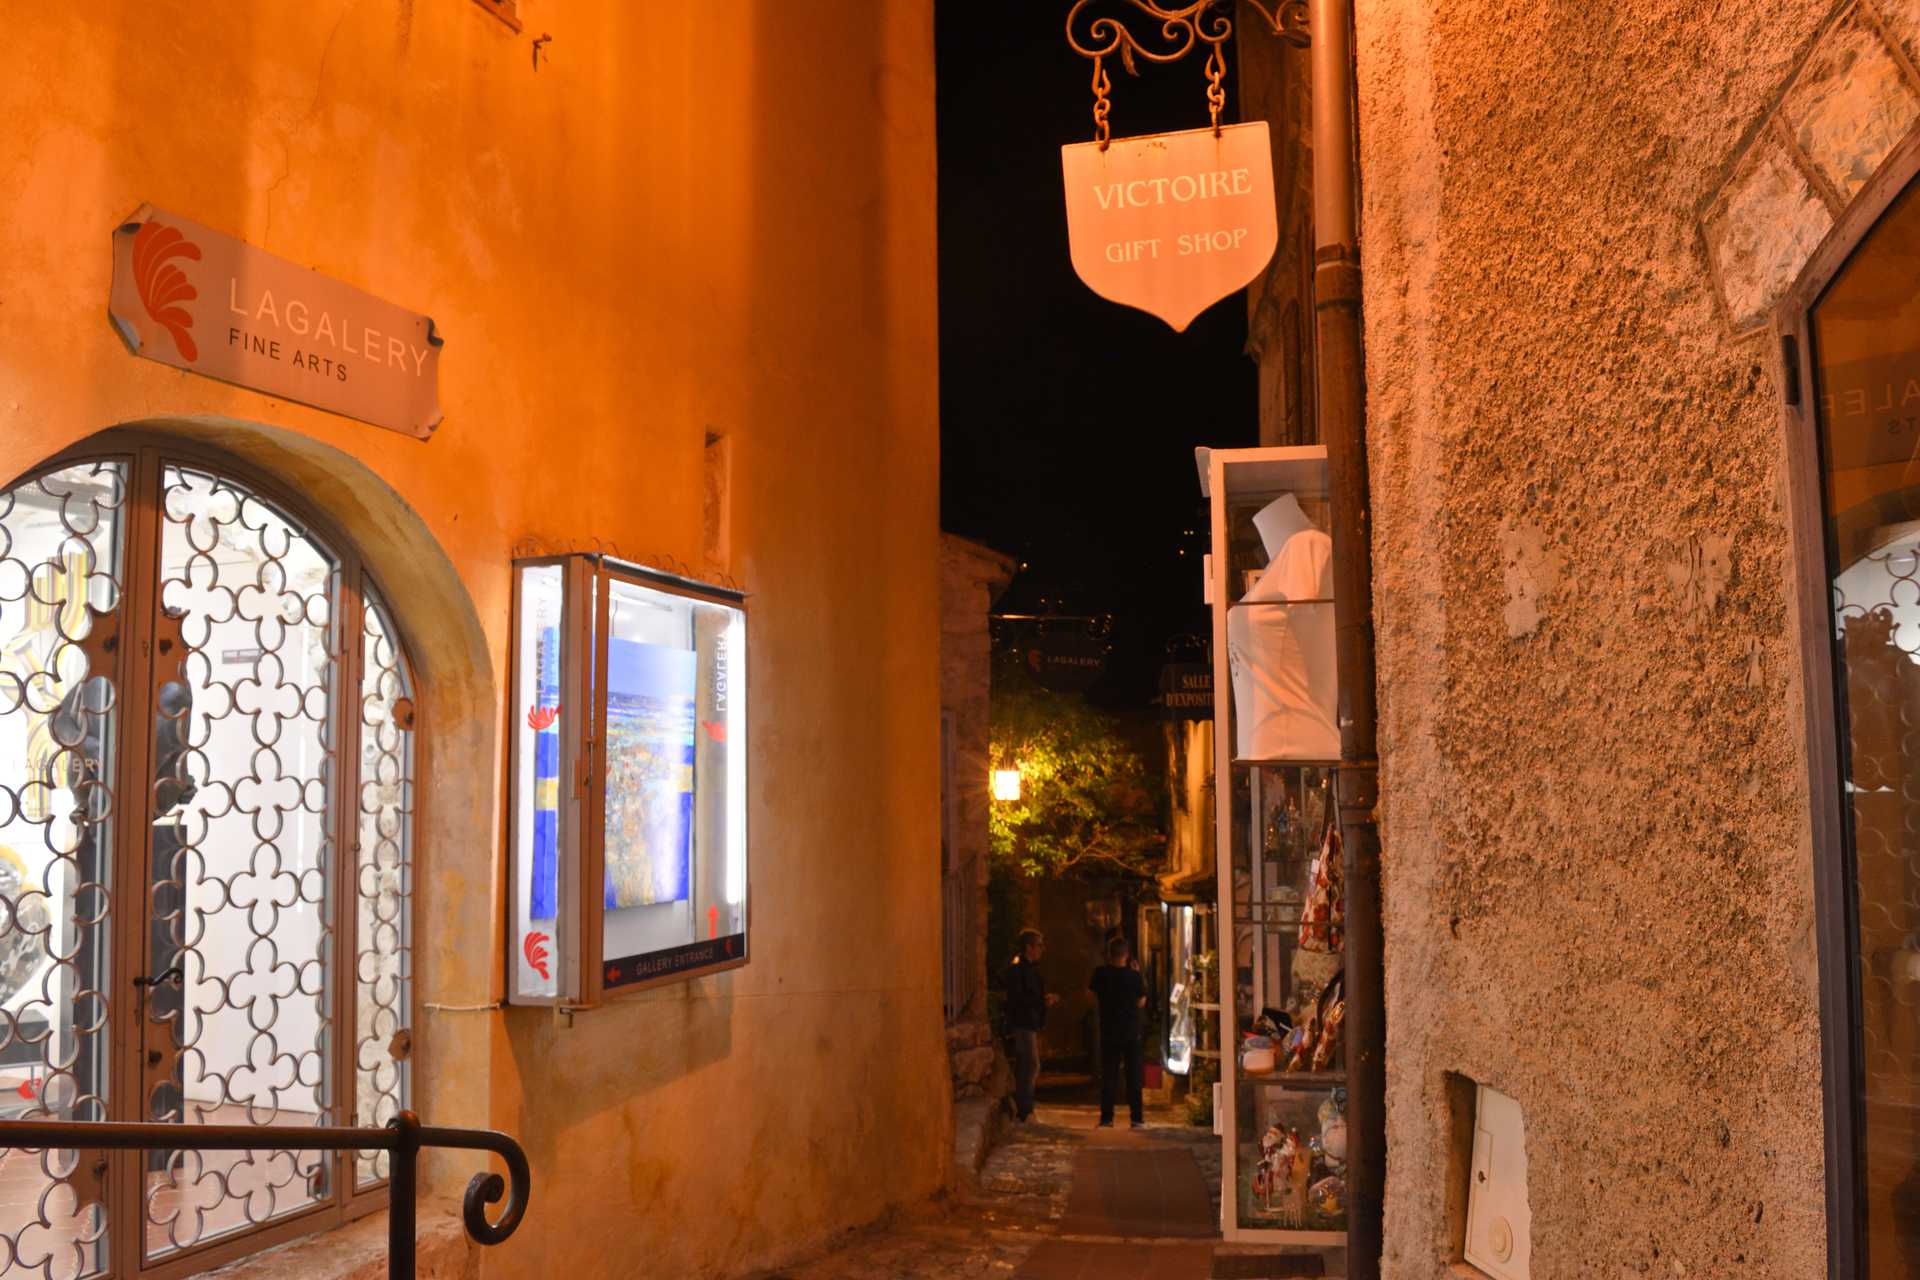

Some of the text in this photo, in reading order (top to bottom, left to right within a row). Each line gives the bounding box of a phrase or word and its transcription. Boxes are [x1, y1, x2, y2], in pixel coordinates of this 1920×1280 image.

[1093, 168, 1252, 210] VICTOIRE
[1105, 228, 1248, 263] GIFT SHOP
[230, 277, 429, 377] LAGALERY
[229, 328, 347, 382] FINE ARTS
[636, 947, 713, 976] GALLERY ENTRANCE
